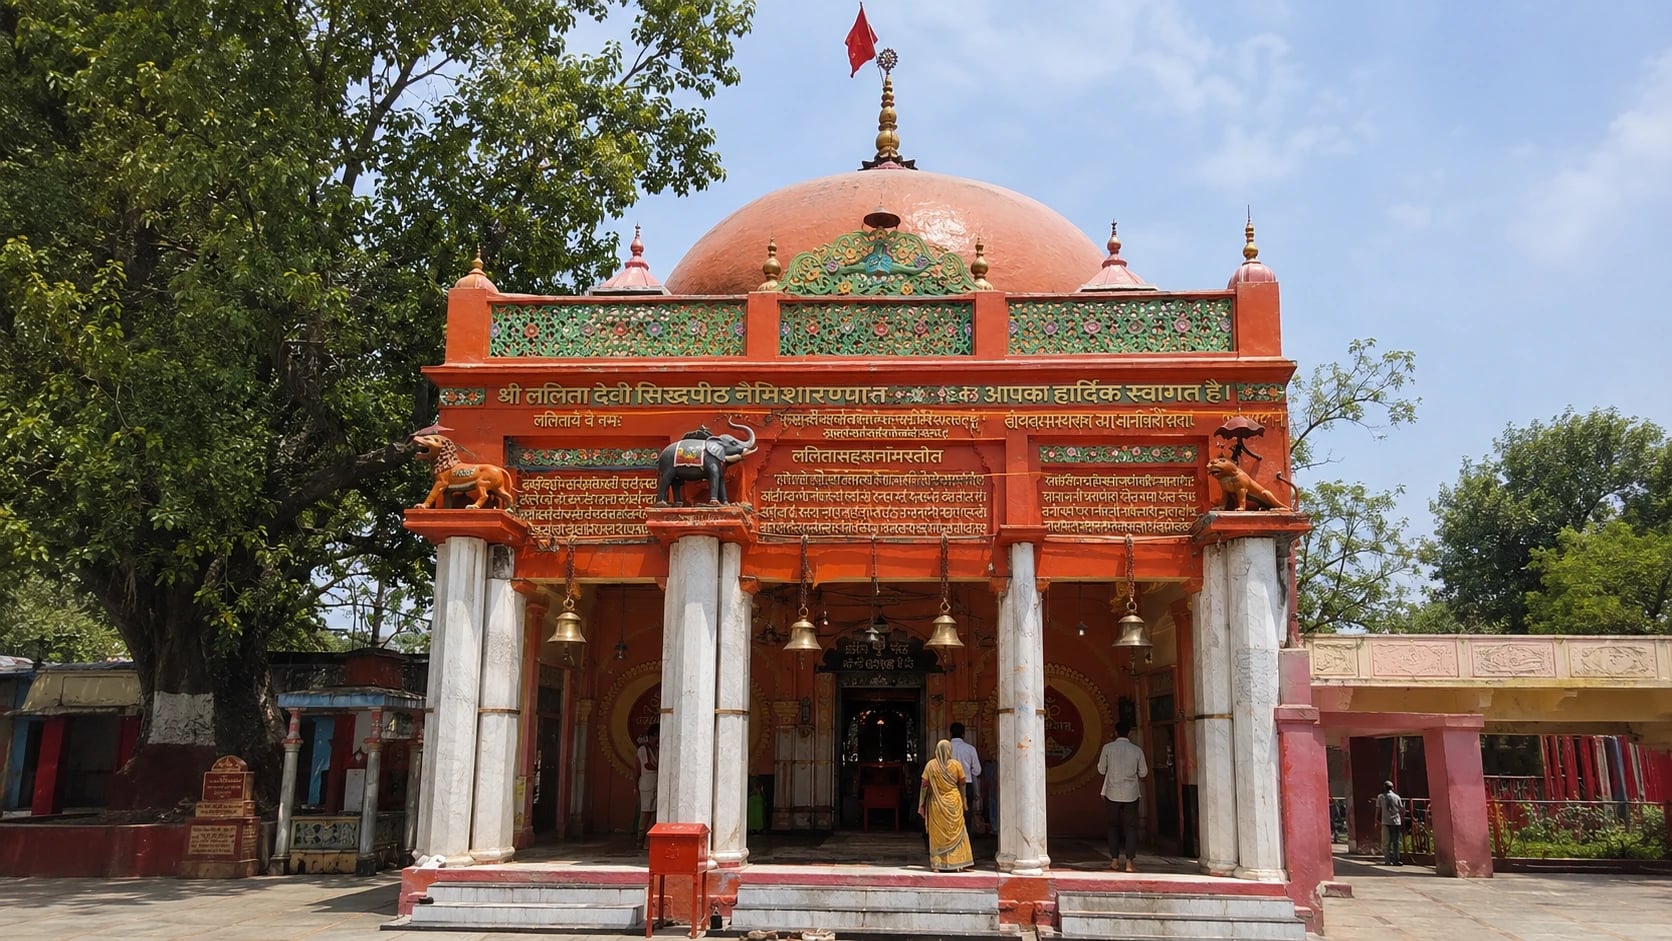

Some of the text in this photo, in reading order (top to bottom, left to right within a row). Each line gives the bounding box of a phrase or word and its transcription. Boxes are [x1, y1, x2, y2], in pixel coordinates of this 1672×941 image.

[497, 382, 522, 405] श्री
[525, 382, 591, 405] ललिता
[593, 381, 632, 405] देवी
[984, 385, 1050, 403] आपका
[1052, 379, 1122, 404] हार्दिक
[1126, 384, 1202, 402] स्वागत
